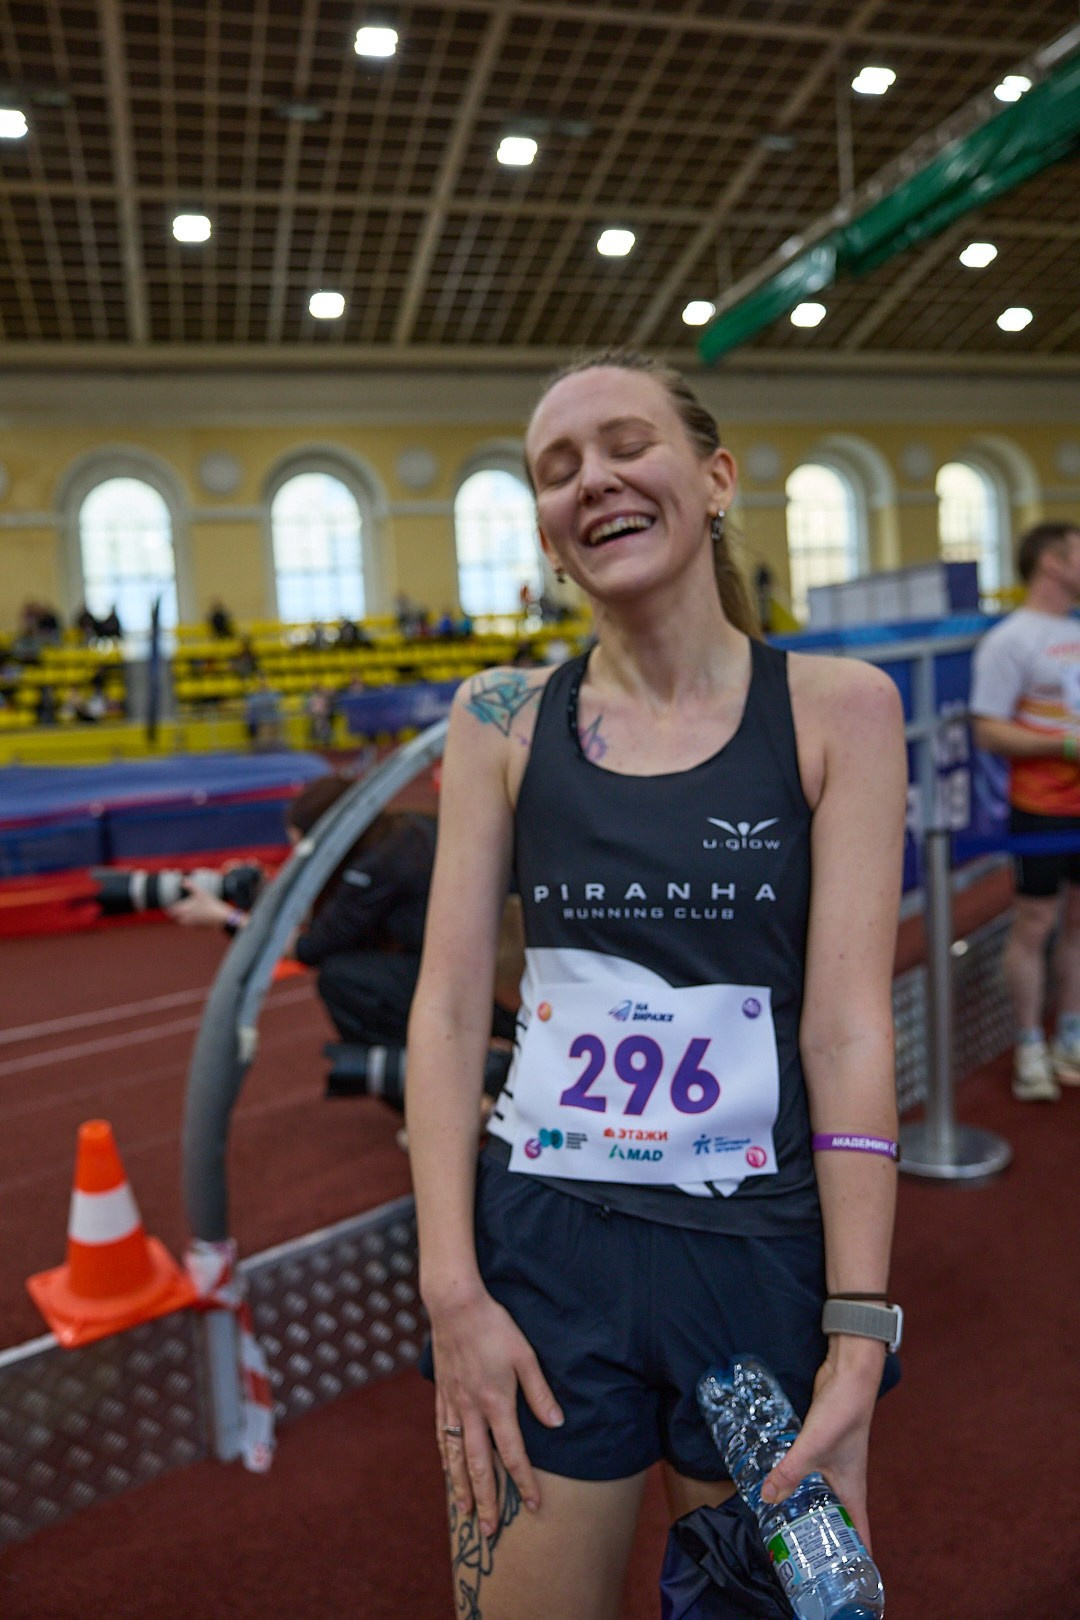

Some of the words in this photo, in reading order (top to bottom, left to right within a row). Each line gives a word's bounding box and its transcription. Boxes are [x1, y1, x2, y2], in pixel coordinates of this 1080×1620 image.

[533, 882, 777, 903] PIRANHA
[563, 907, 664, 920] RUNNING
[674, 907, 735, 920] CLUB
[559, 1033, 721, 1116] 296
